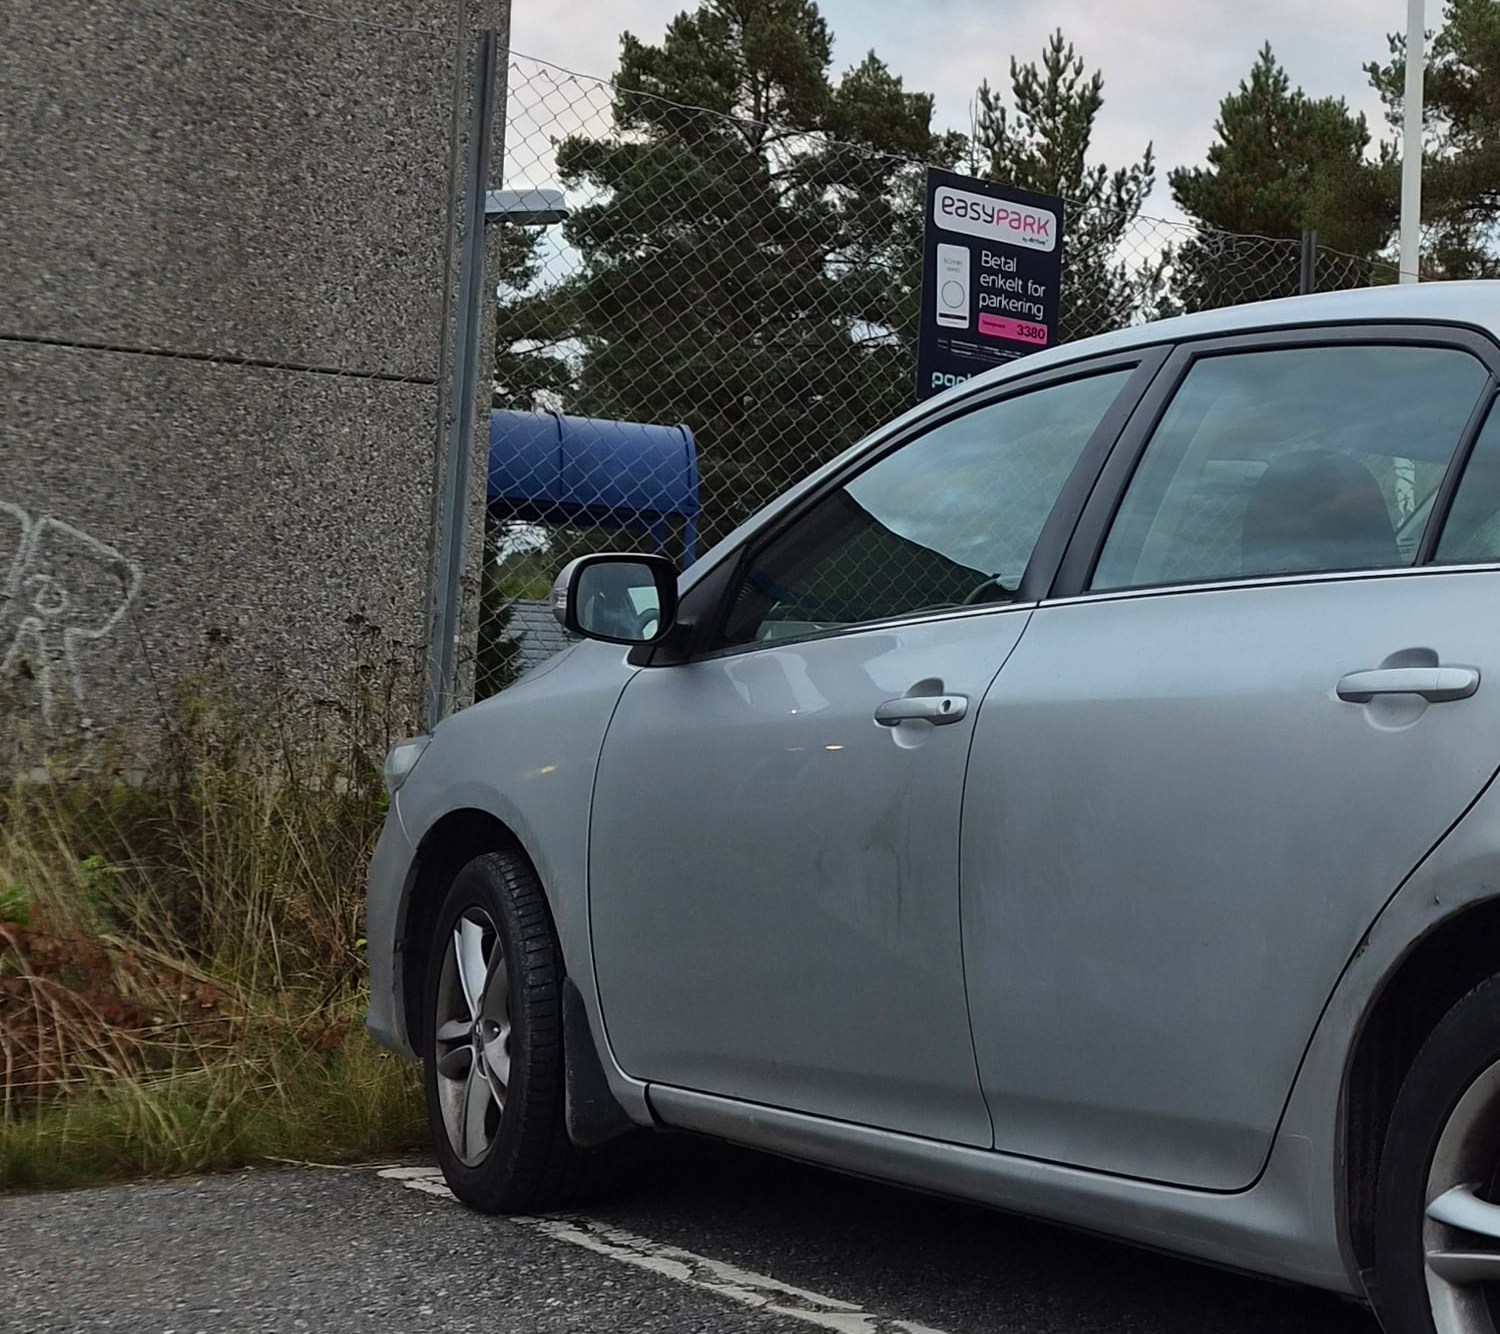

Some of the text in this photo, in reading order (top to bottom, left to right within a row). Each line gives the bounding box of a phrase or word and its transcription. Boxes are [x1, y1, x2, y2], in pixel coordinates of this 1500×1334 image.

[981, 250, 1017, 273] Betal
[980, 273, 1046, 298] enkelt for
[979, 293, 1044, 320] parkering
[1017, 323, 1046, 340] 3380
